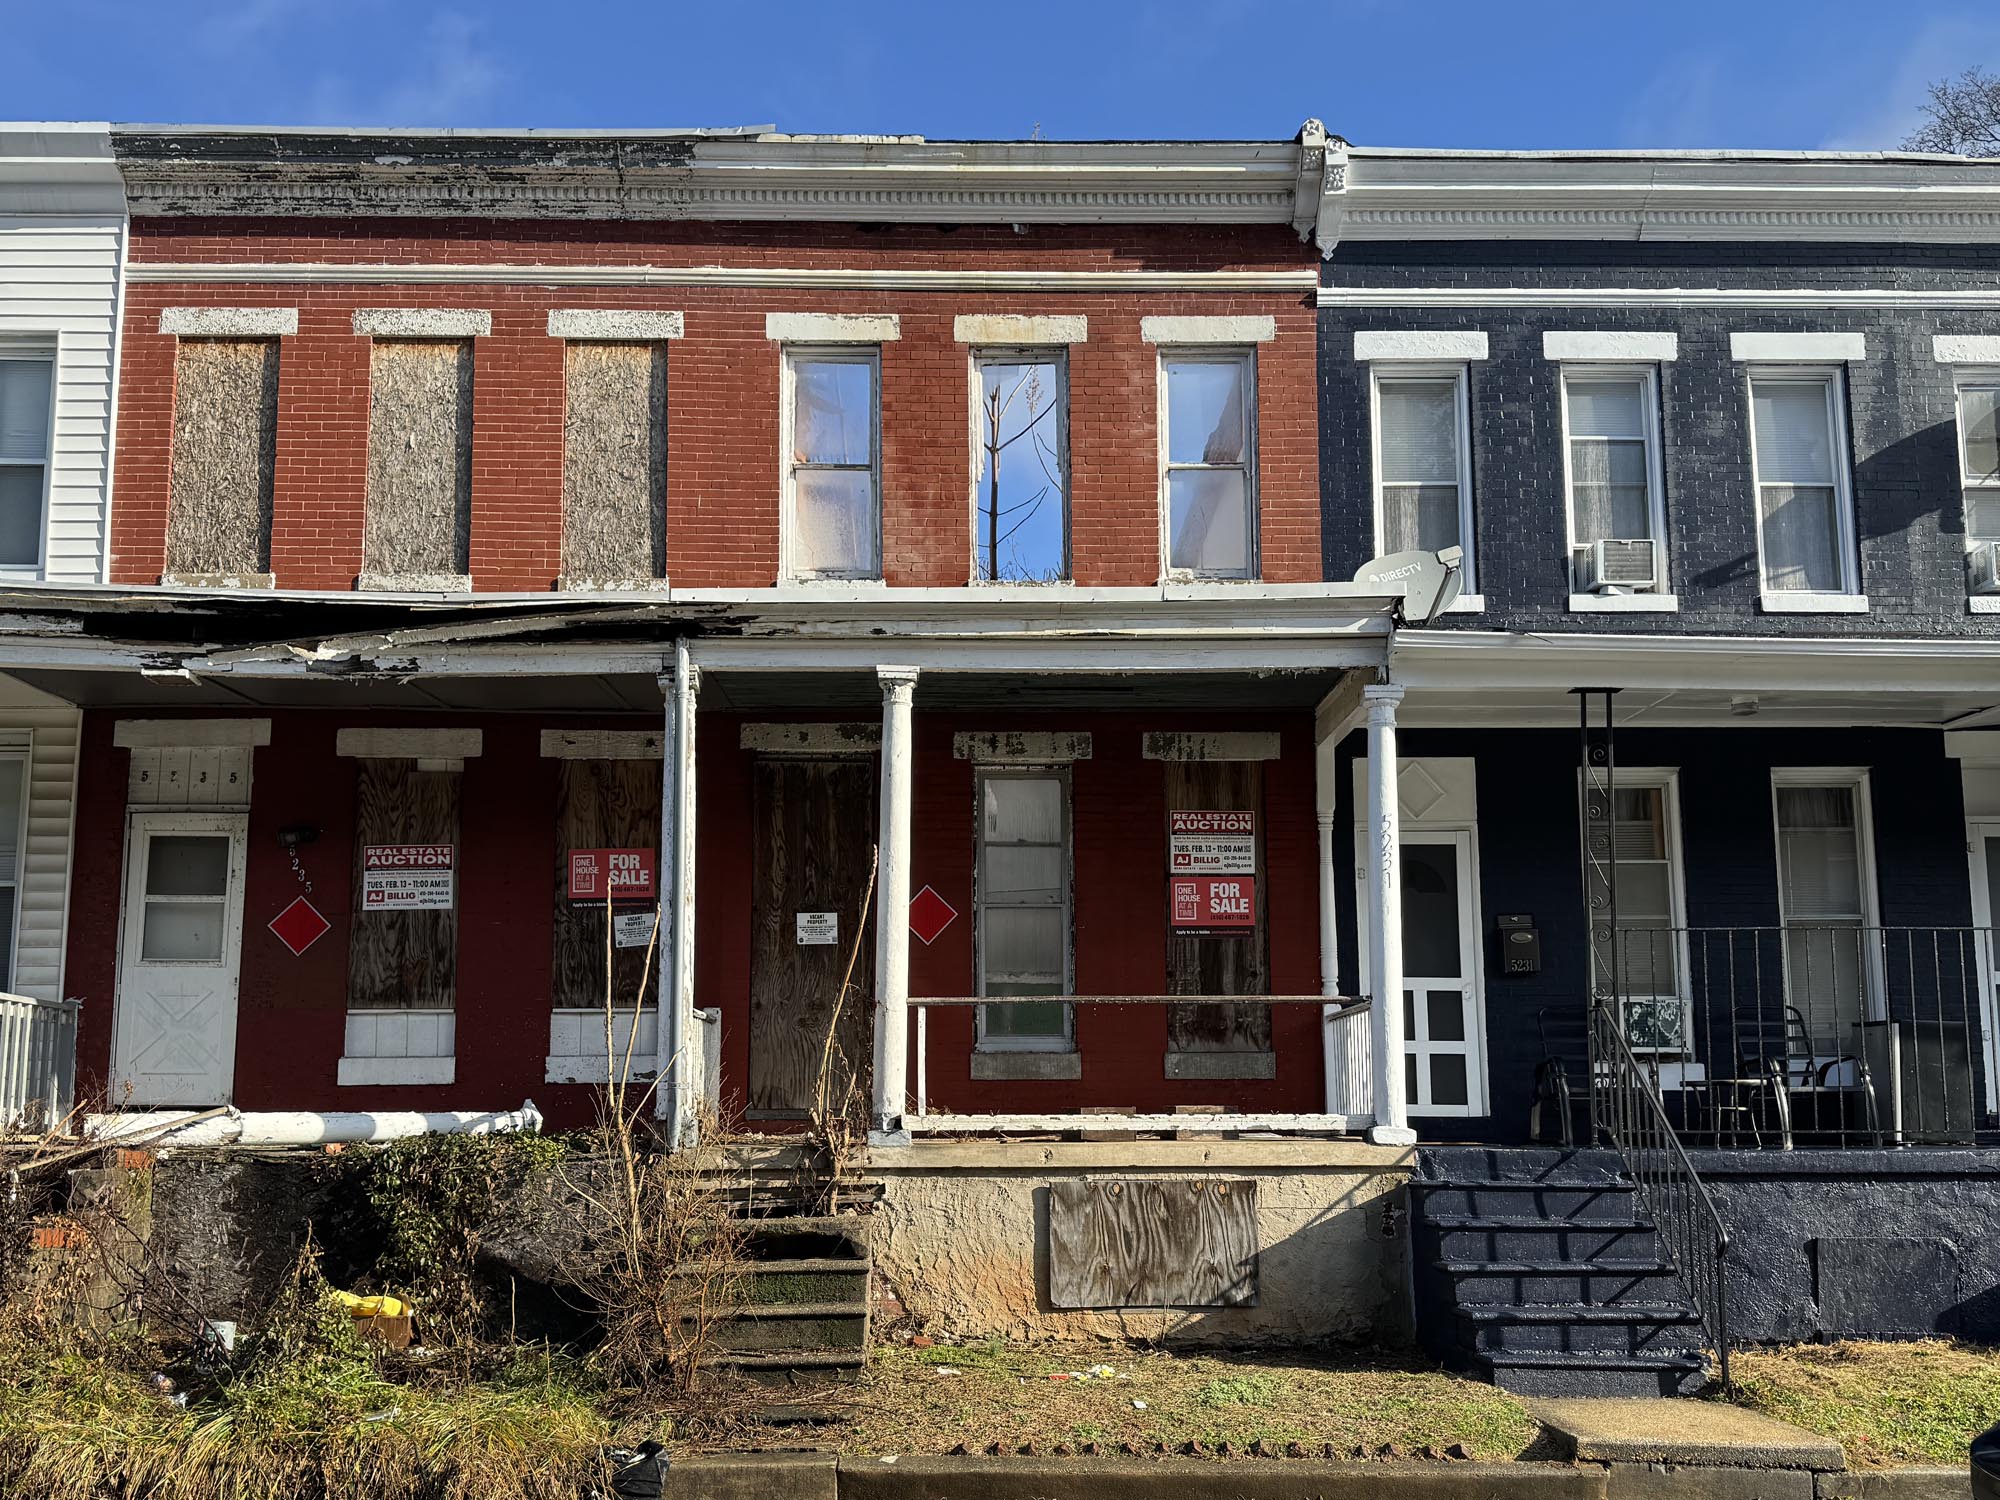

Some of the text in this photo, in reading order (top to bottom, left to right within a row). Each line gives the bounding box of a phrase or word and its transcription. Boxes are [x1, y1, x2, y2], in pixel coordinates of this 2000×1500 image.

[1380, 562, 1422, 582] DIRECTV
[1173, 821, 1252, 830] AUCTION
[1380, 814, 1392, 888] 5231
[368, 855, 450, 865] AUCTION
[609, 854, 640, 869] FOR
[289, 844, 312, 894] 5235
[609, 870, 649, 885] SALE
[367, 881, 384, 889] TUES.
[1210, 883, 1240, 897] FOR
[369, 892, 382, 900] AJ
[1210, 898, 1249, 913] SALE
[1511, 960, 1534, 971] 5231
